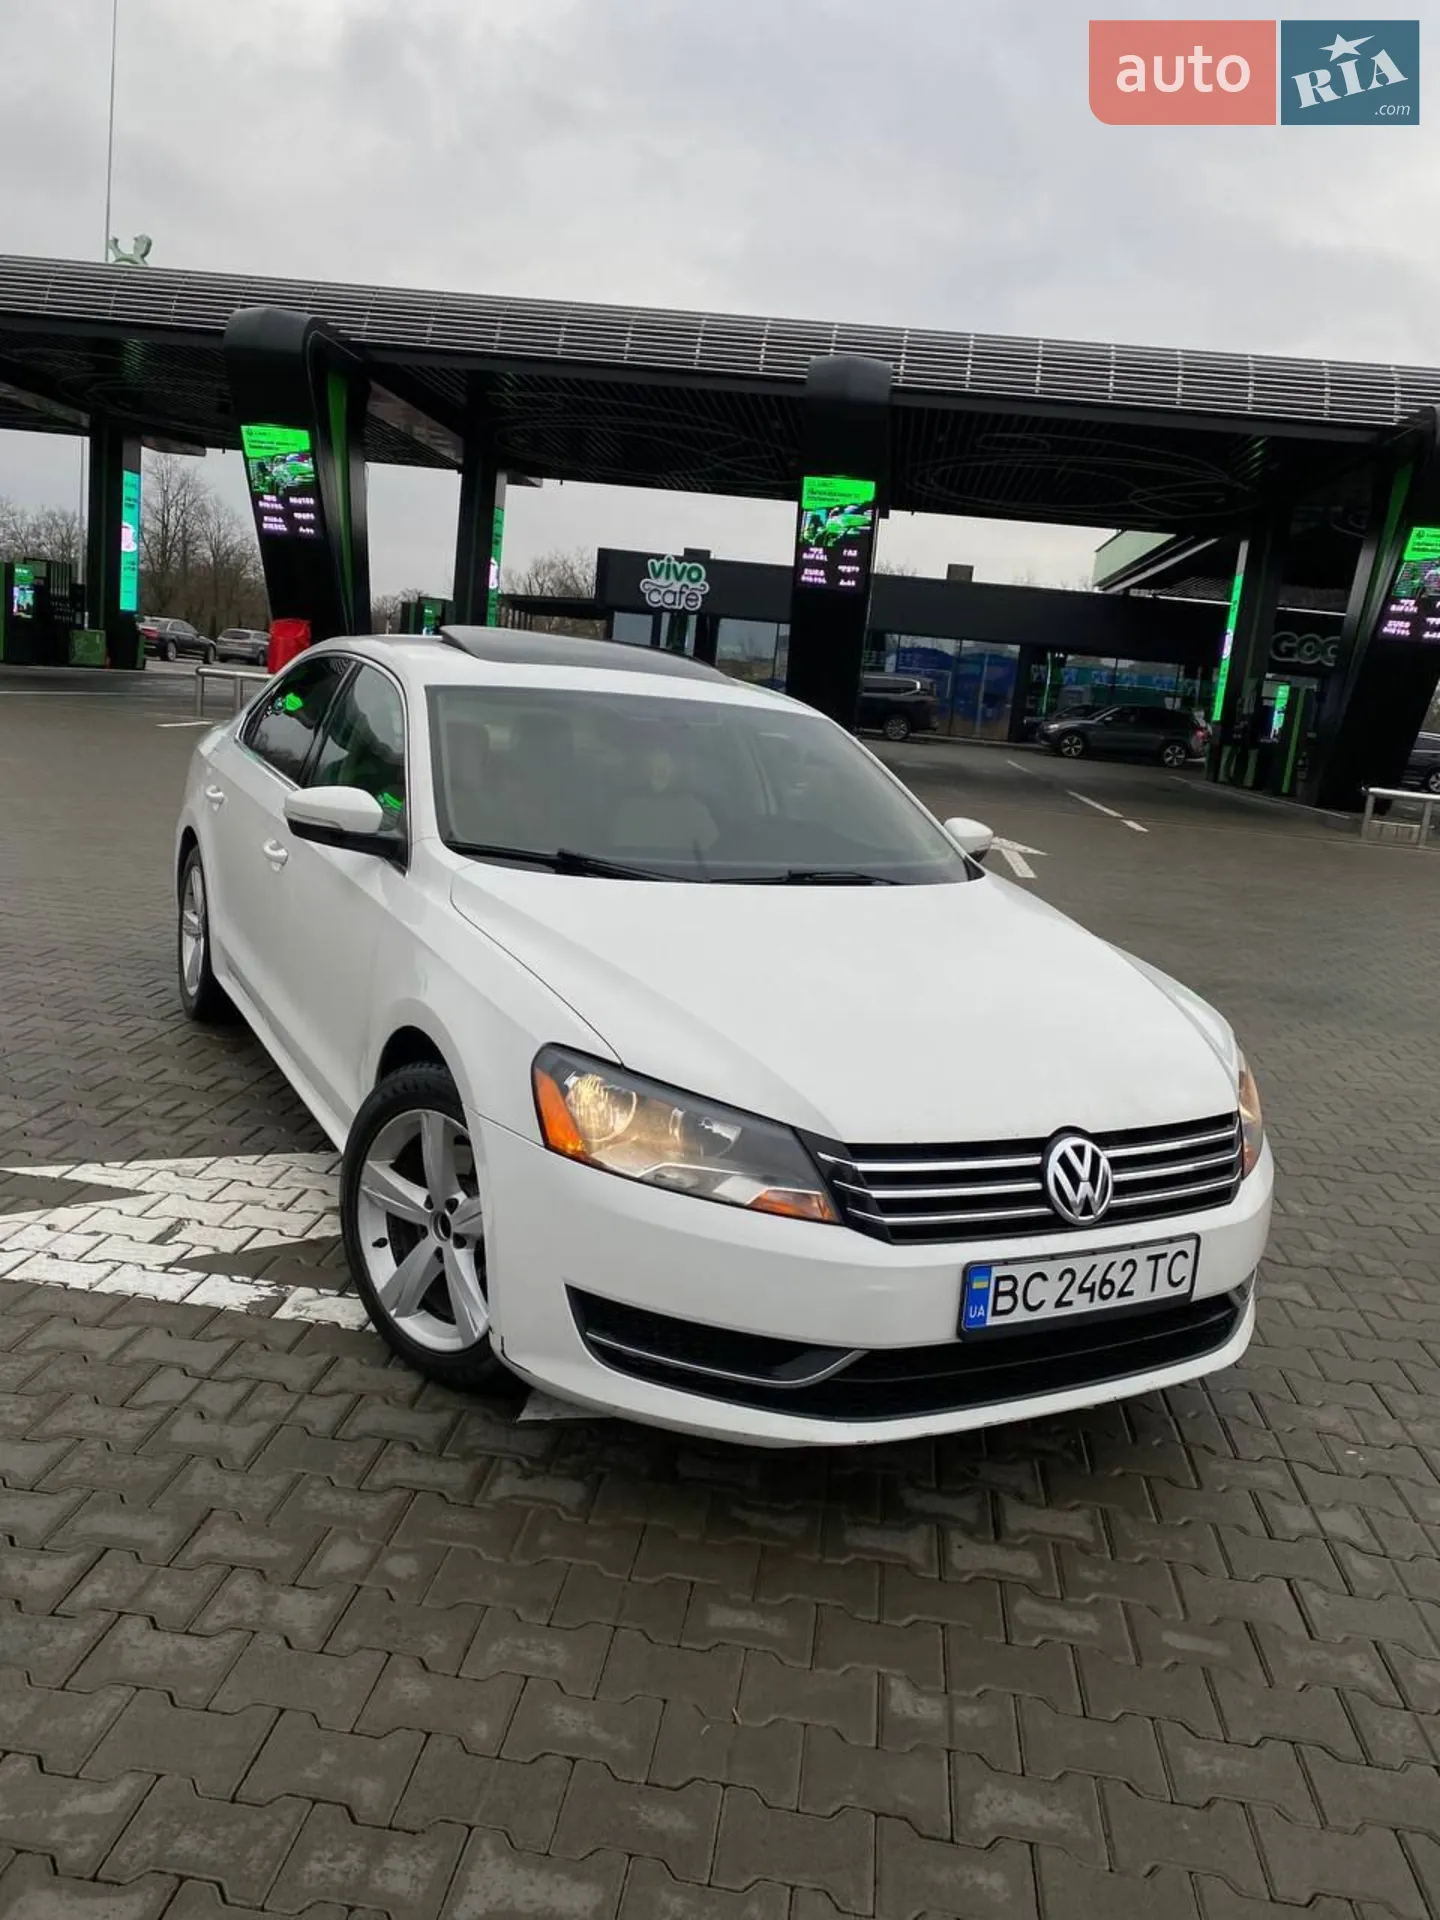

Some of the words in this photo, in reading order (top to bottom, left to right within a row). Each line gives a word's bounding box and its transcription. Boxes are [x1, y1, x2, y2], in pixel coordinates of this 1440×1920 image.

[648, 555, 704, 583] vivo
[991, 1271, 1049, 1317] BC
[1054, 1258, 1138, 1309] 2462
[1147, 1250, 1189, 1293] TC
[969, 1305, 985, 1319] UA
